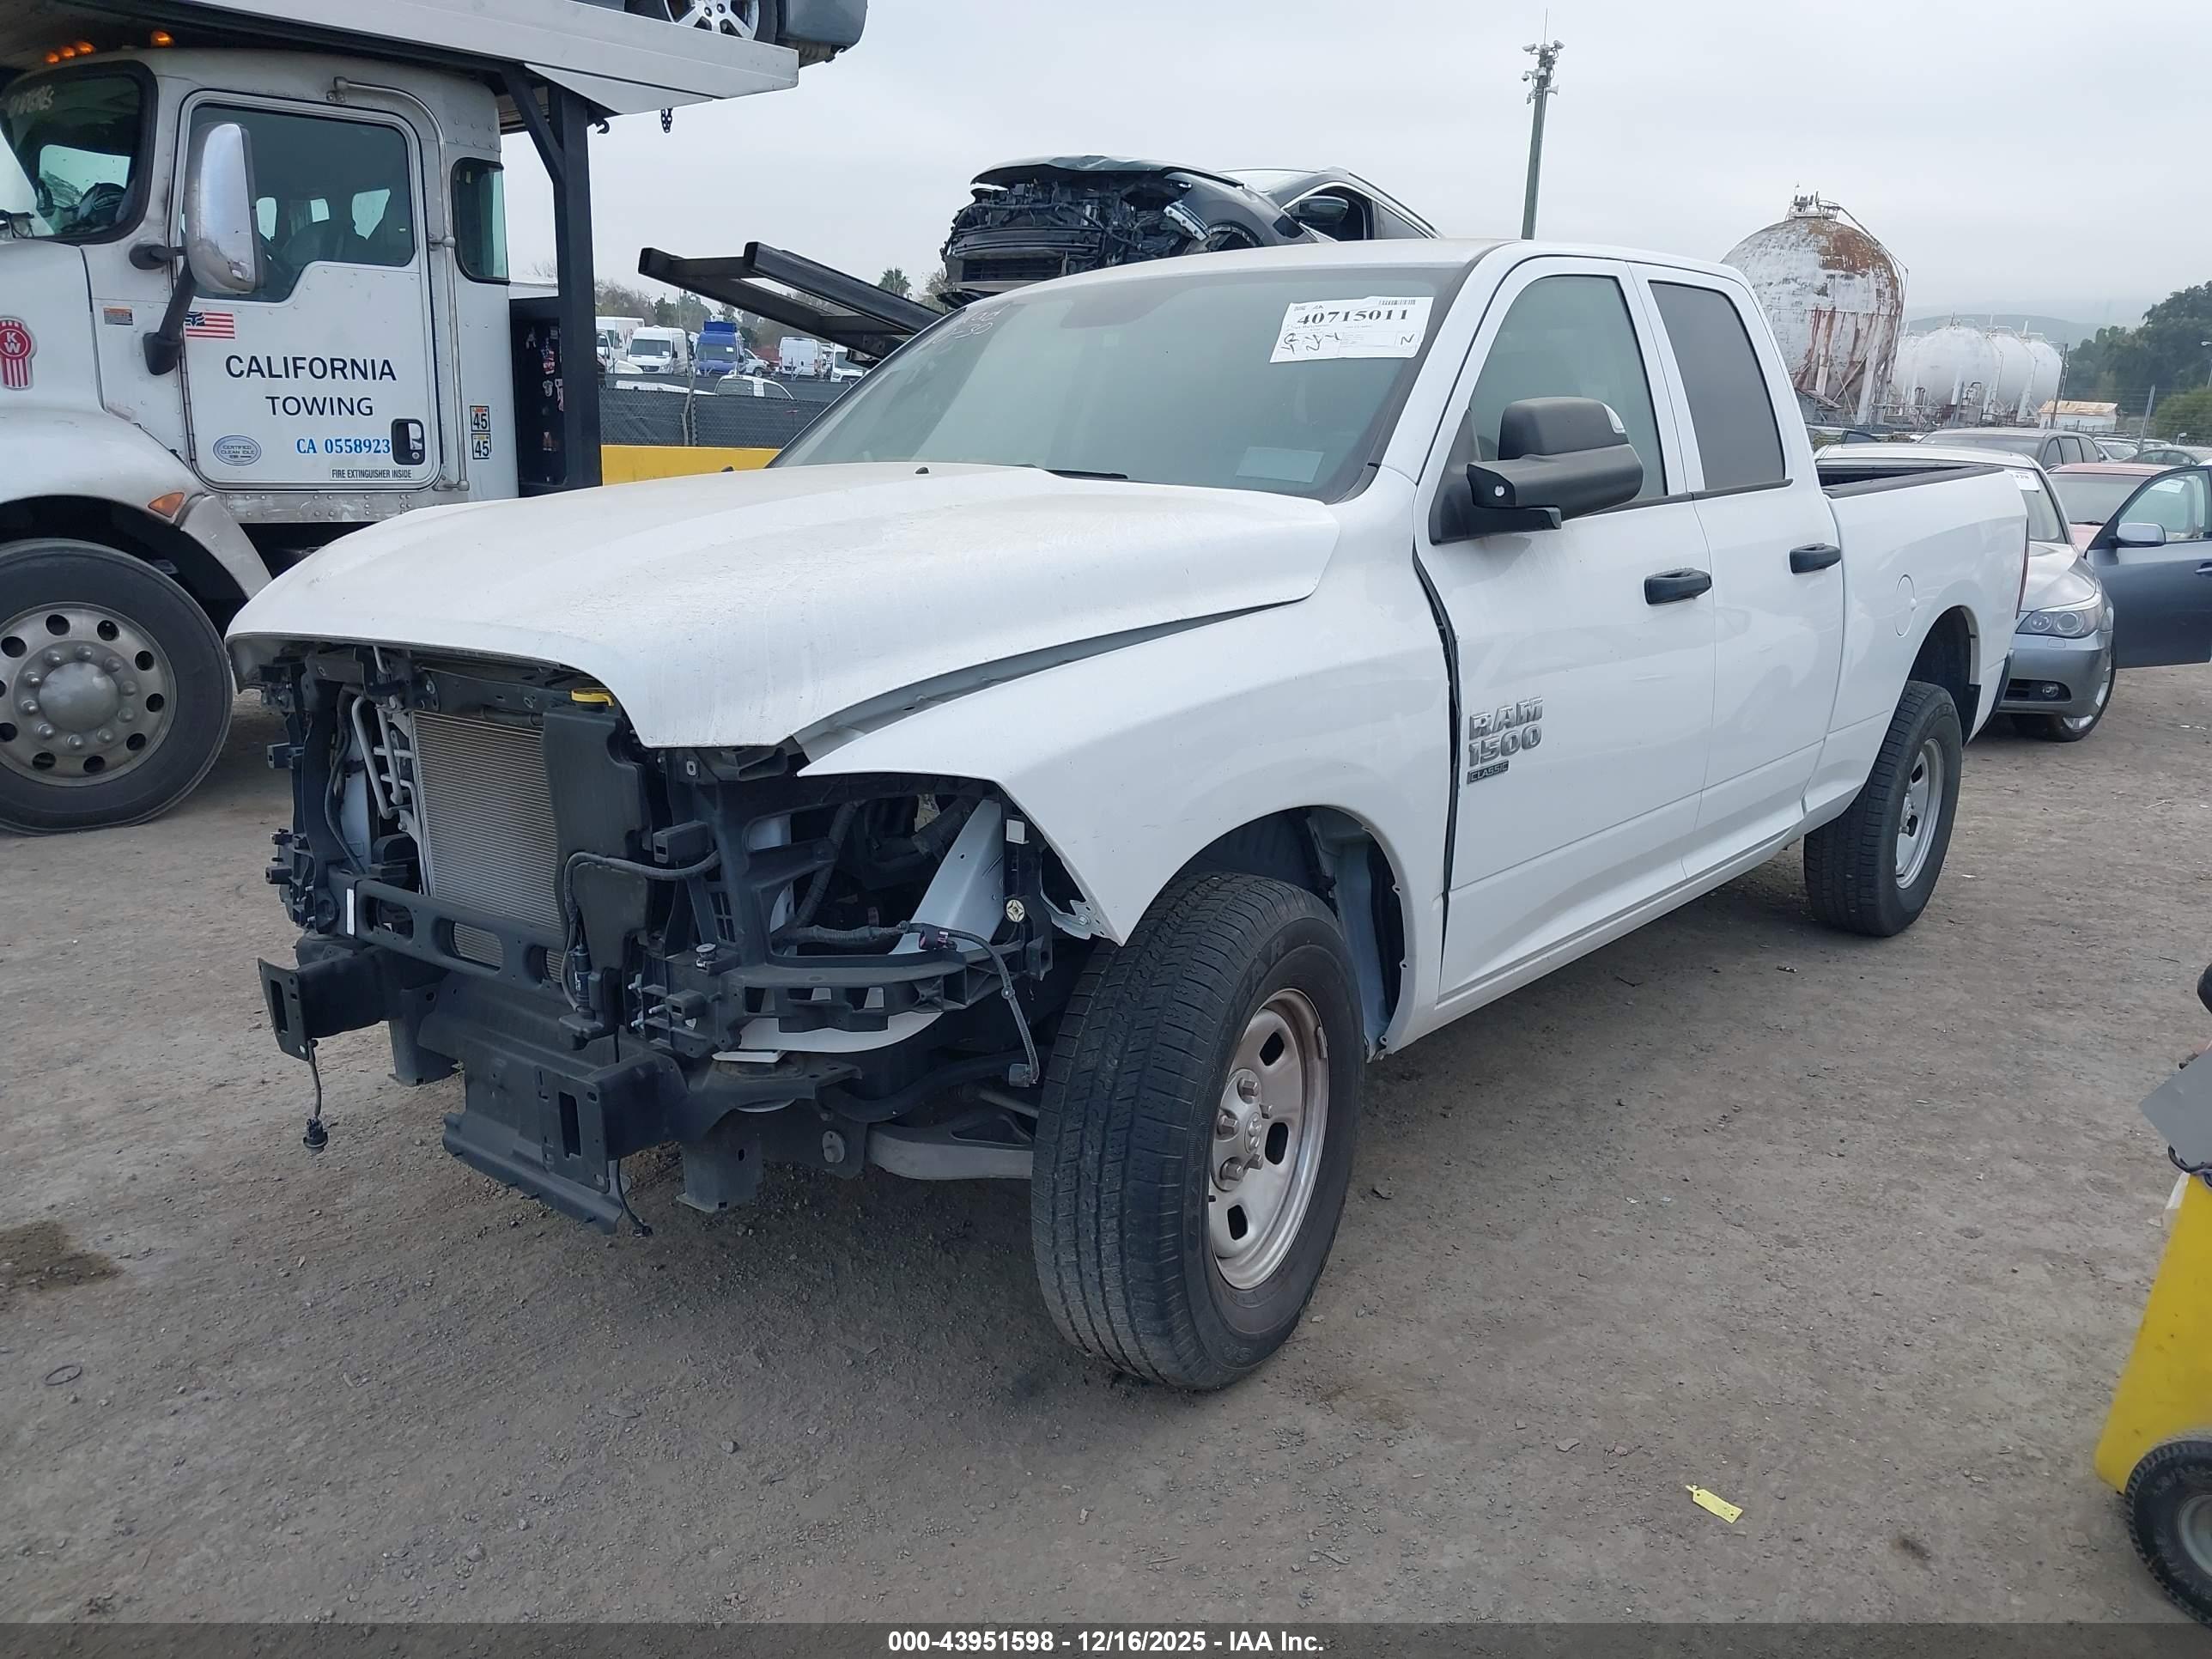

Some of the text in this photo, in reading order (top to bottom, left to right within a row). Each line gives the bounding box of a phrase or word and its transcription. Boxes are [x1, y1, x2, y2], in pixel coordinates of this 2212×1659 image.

[1297, 309, 1408, 325] 40715011
[225, 355, 398, 381] CALIFORNIA
[264, 396, 374, 416] TOWING
[473, 413, 488, 429] 45
[296, 438, 391, 454] CA 0558923
[475, 441, 489, 457] 45
[332, 469, 412, 478] FIRE EXTINGUISHER INSIDE
[1468, 696, 1543, 740] RAM
[1468, 724, 1542, 767] 1500
[1470, 762, 1509, 782] CLASSIC
